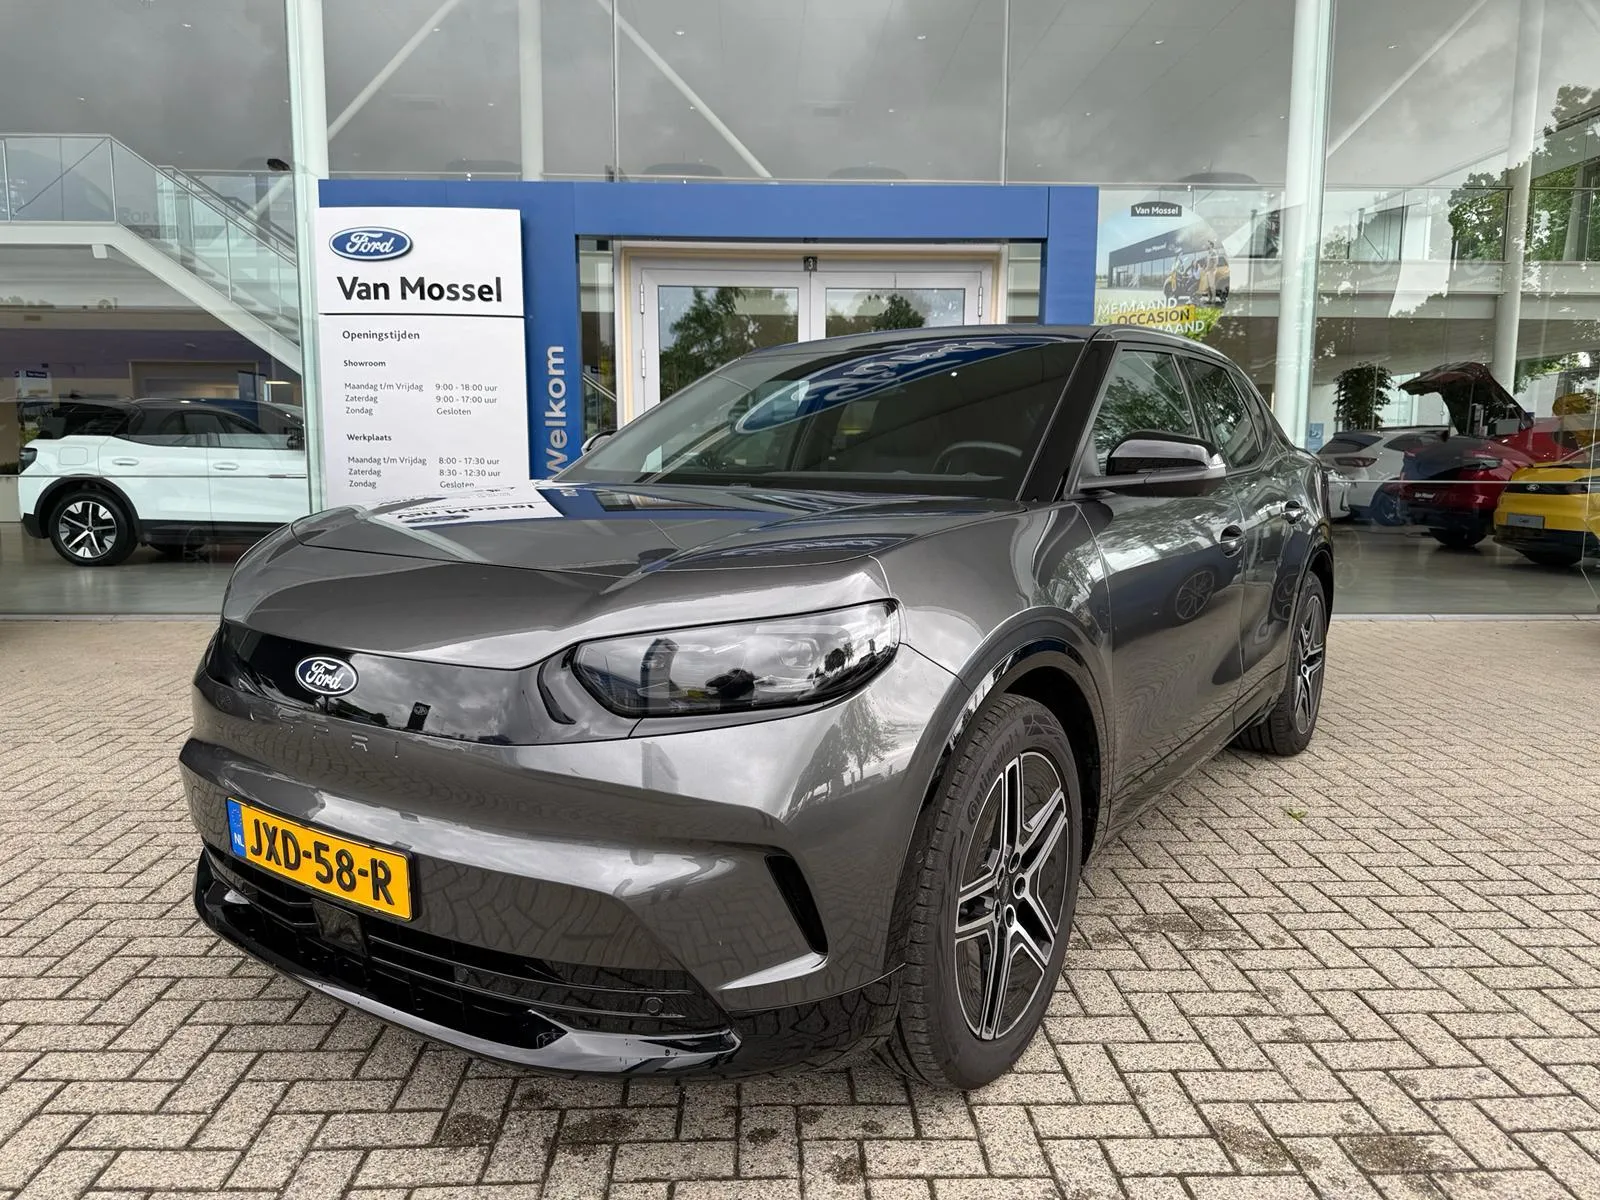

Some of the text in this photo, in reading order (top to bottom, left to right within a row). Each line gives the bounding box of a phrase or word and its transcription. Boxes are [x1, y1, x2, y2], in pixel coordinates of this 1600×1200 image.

[1135, 206, 1179, 215] Van Mossel
[345, 232, 395, 253] Ford
[336, 276, 503, 303] Van Mossel
[1117, 308, 1190, 326] OCCASION
[341, 329, 420, 342] Openingstijden
[343, 359, 387, 368] Showroom
[344, 382, 379, 393] Maandag
[379, 382, 395, 391] t/m
[395, 382, 425, 394] Vrijdag
[434, 383, 454, 392] 9:00
[460, 383, 483, 392] 18:00
[484, 384, 498, 392] uur
[344, 394, 379, 404] Zaterdag
[435, 394, 455, 404] 9:00
[461, 395, 483, 404] 17:00
[484, 396, 498, 404] uur
[345, 406, 472, 417] Zondag Gesloten
[544, 346, 568, 480] Welkom
[346, 433, 392, 443] Werkplaats
[347, 456, 382, 466] Maandag
[382, 456, 398, 465] t/m
[398, 456, 428, 467] Vrijdag
[438, 457, 458, 466] 8:00
[463, 457, 486, 466] 17:30
[348, 467, 382, 478] Zaterdag
[439, 469, 458, 478] 8:30
[464, 469, 487, 478] 12:30
[348, 479, 475, 490] Zondag Gesloten
[305, 660, 345, 690] Ford
[233, 831, 246, 848] NL
[250, 818, 395, 905] JXD-58-R
